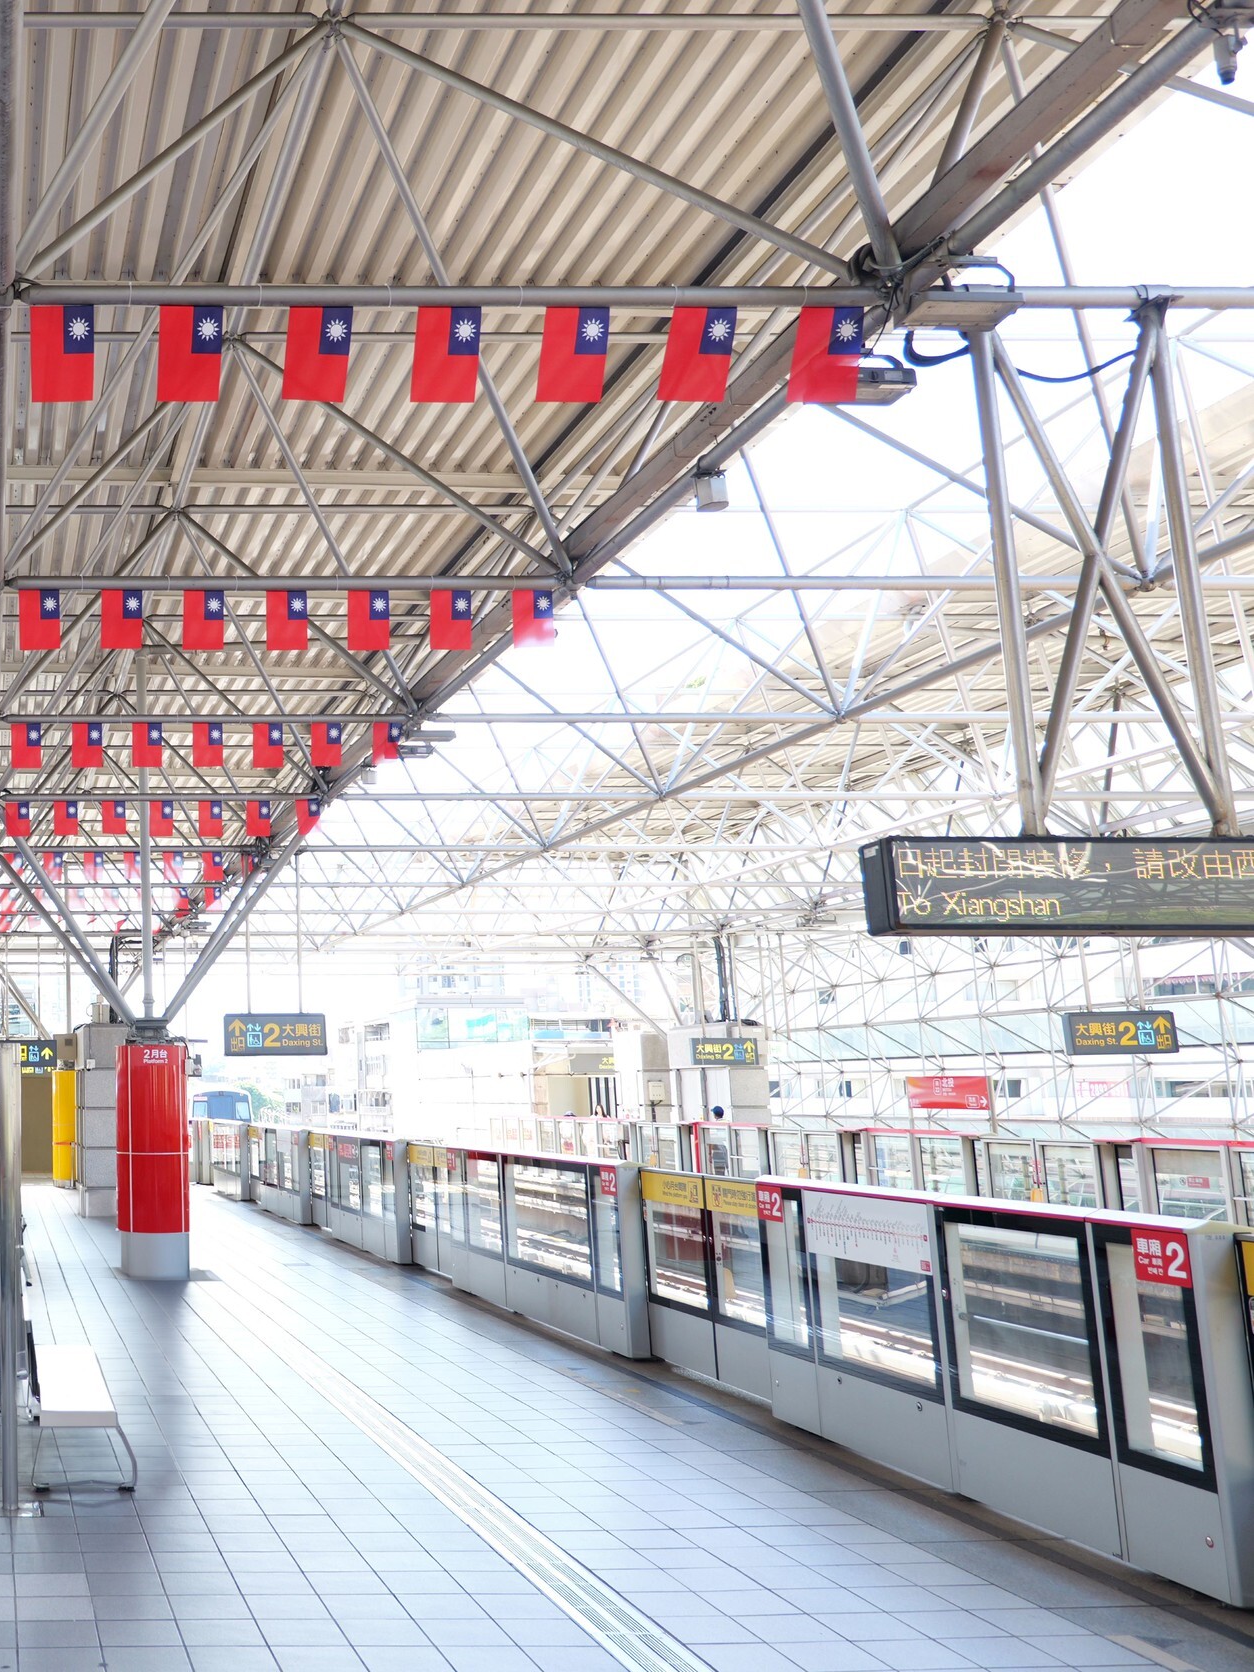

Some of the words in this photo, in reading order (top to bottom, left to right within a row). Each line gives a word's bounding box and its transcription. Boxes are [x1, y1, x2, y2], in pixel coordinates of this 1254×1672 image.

[897, 891, 931, 915] To
[943, 891, 1061, 922] Xiangshan
[263, 1022, 281, 1047] 2
[282, 1023, 321, 1037] 大興街
[1075, 1022, 1116, 1036] 大興街
[1118, 1021, 1138, 1046] 2
[282, 1039, 311, 1047] Daxing
[312, 1038, 323, 1047] St.
[1075, 1038, 1105, 1047] Daxing
[1106, 1037, 1119, 1045] St.
[143, 1049, 168, 1059] 2月台
[722, 1043, 735, 1060] 2
[609, 1172, 617, 1192] 2
[771, 1192, 782, 1217] 2
[1136, 1237, 1162, 1257] 車廂
[1137, 1256, 1150, 1265] Car
[1165, 1241, 1188, 1279] 2
